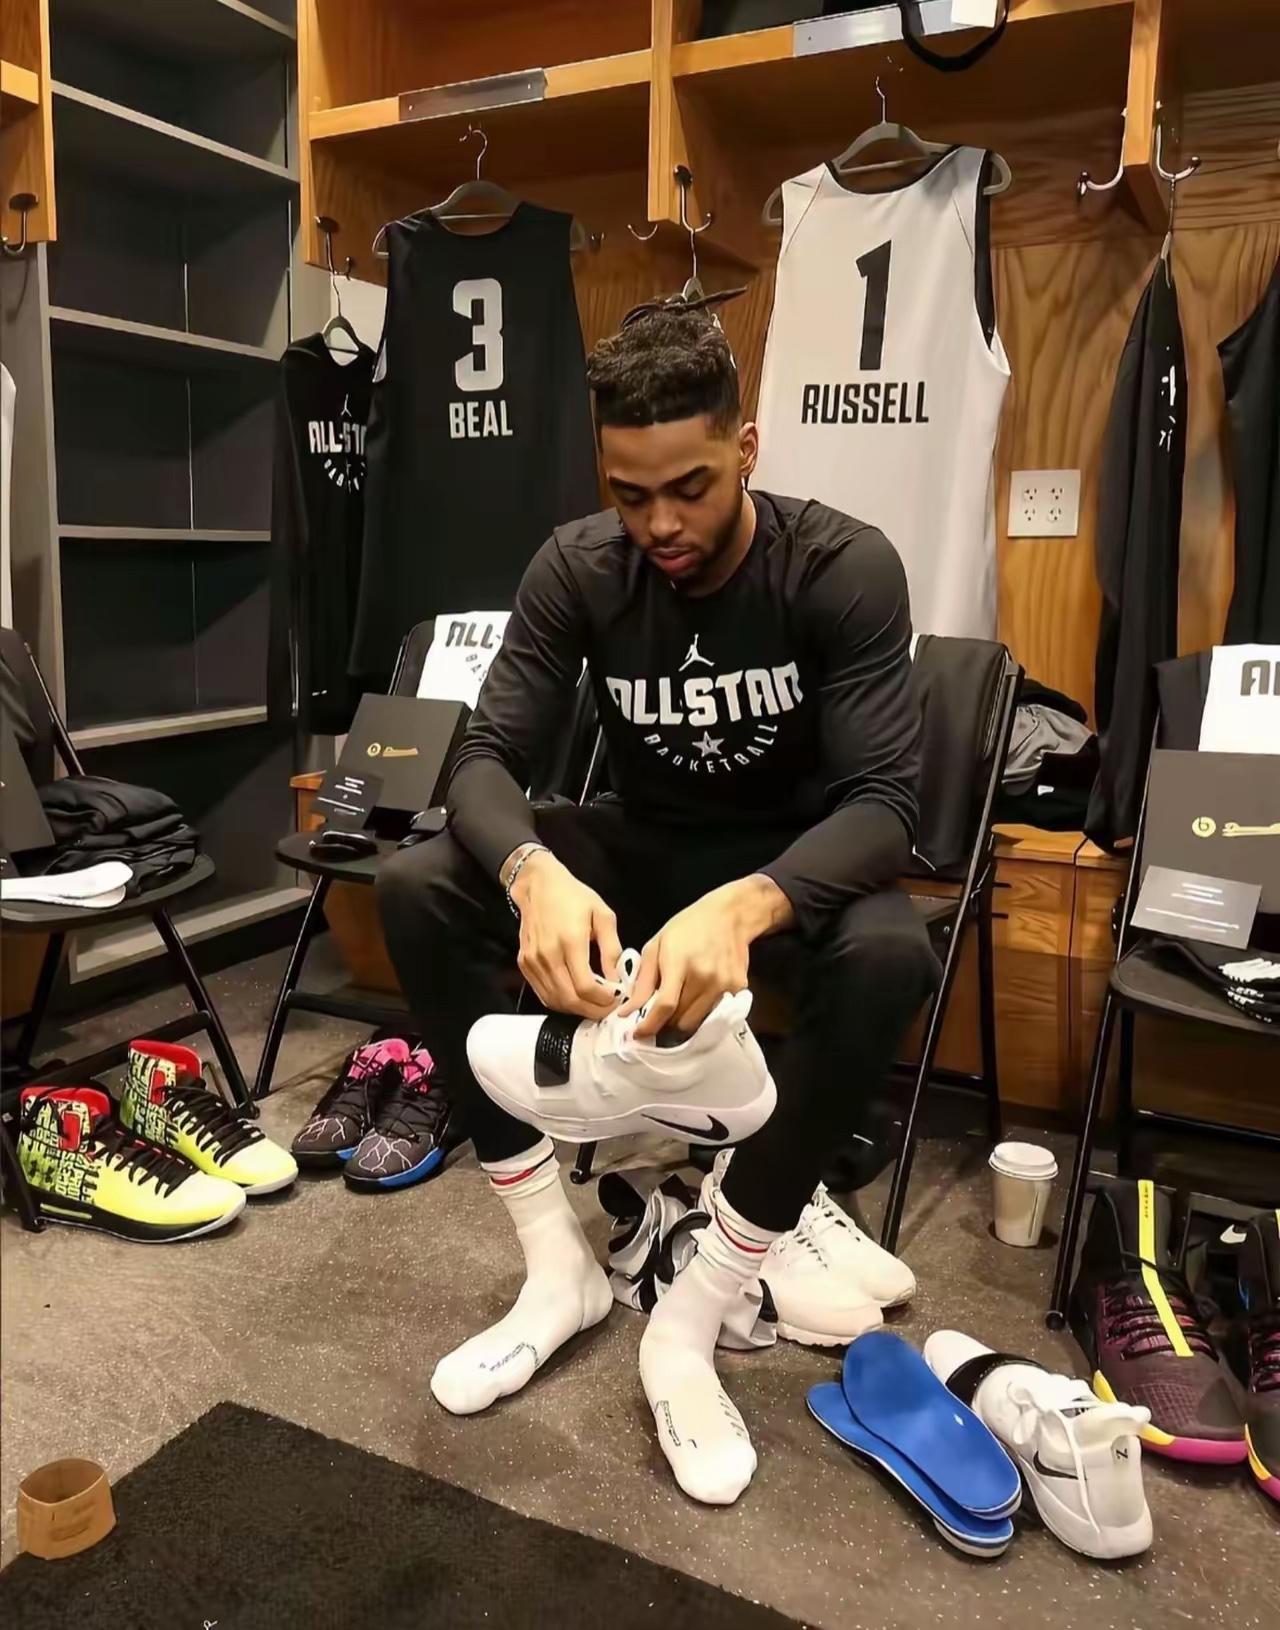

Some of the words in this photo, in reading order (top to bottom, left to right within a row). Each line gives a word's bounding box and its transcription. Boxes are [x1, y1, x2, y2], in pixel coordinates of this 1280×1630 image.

[452, 278, 504, 391] 3
[855, 239, 892, 371] 1
[449, 400, 513, 439] BEAL
[801, 381, 929, 424] RUSSELL
